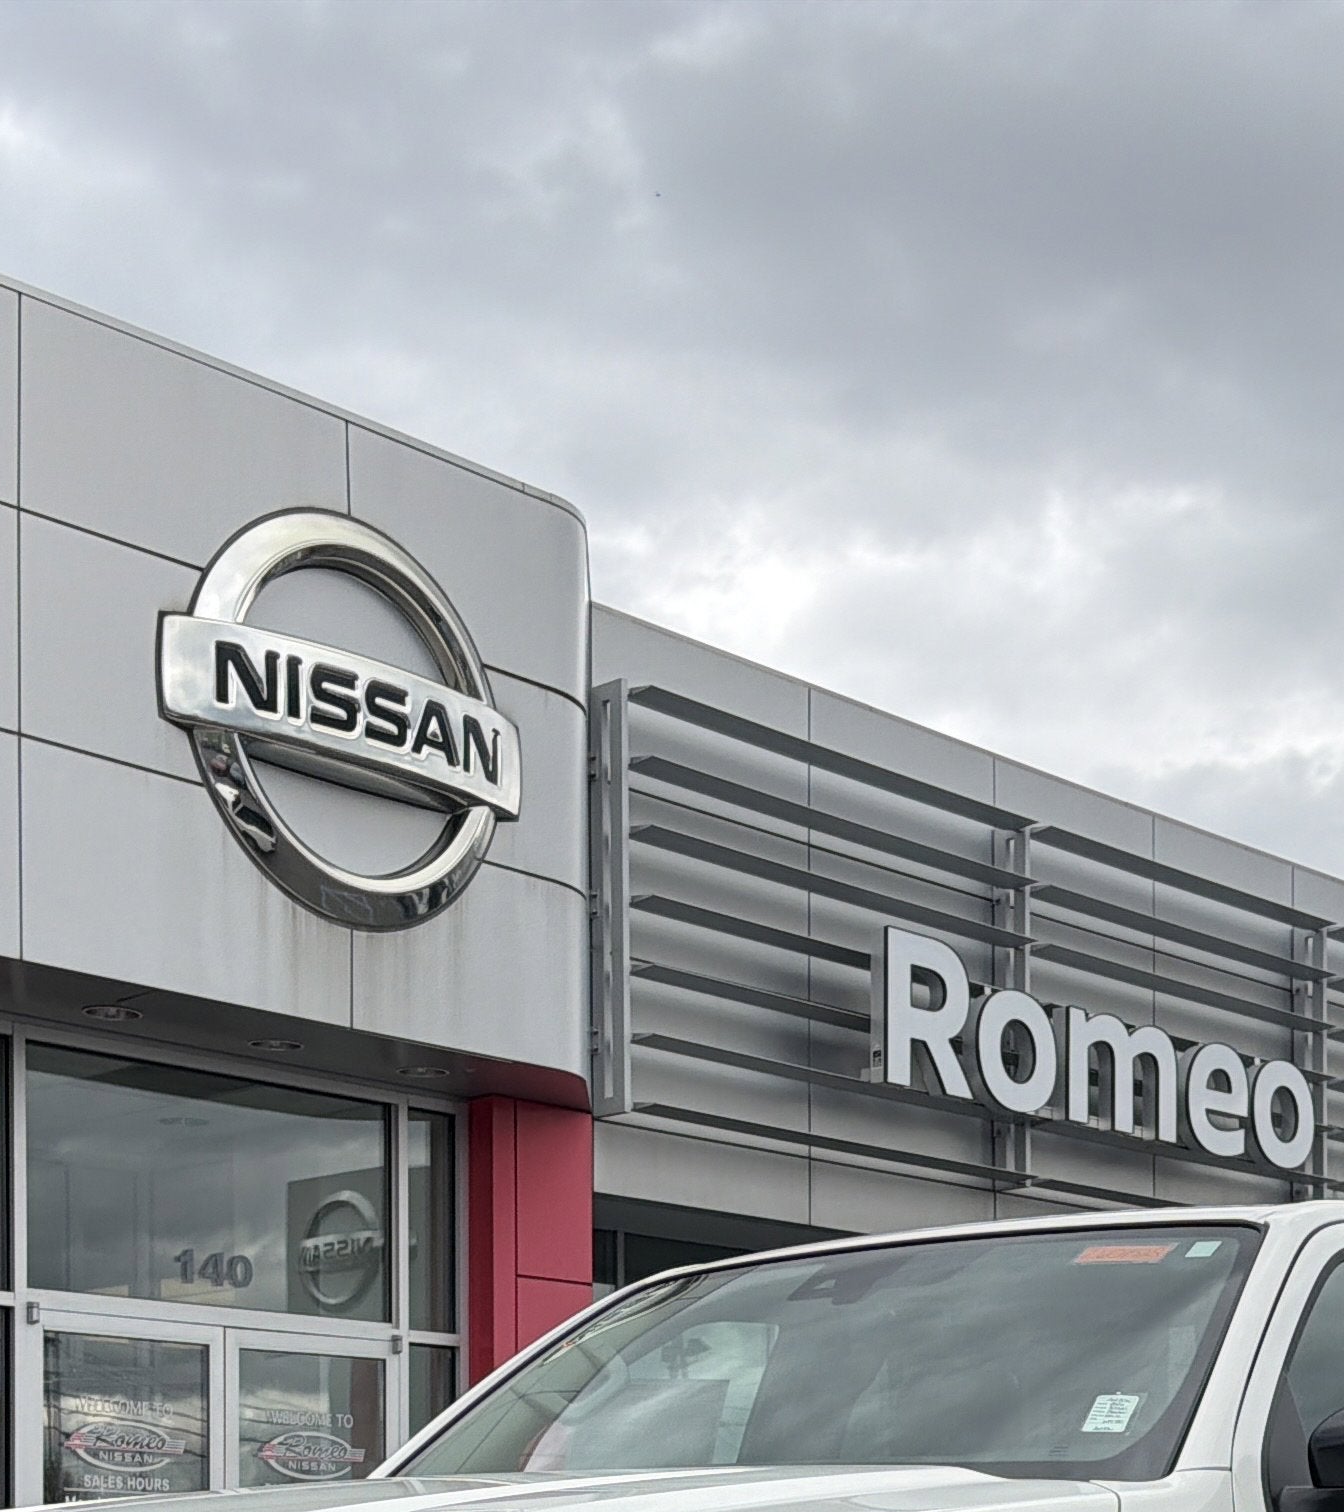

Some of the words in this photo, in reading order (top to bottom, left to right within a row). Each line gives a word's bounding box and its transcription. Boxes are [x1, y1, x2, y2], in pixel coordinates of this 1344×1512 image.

[213, 640, 503, 786] NISSAN
[884, 925, 1315, 1169] Romeo
[173, 1249, 253, 1288] 140
[151, 1402, 174, 1418] TO
[269, 1410, 333, 1427] WELCOME
[336, 1413, 354, 1429] TO
[87, 1422, 167, 1450] Romeo
[278, 1434, 348, 1459] Romeo
[99, 1450, 153, 1464] NISSAN
[288, 1460, 336, 1472] NISSAN
[83, 1474, 124, 1490] SALES
[127, 1476, 170, 1491] HOURS
